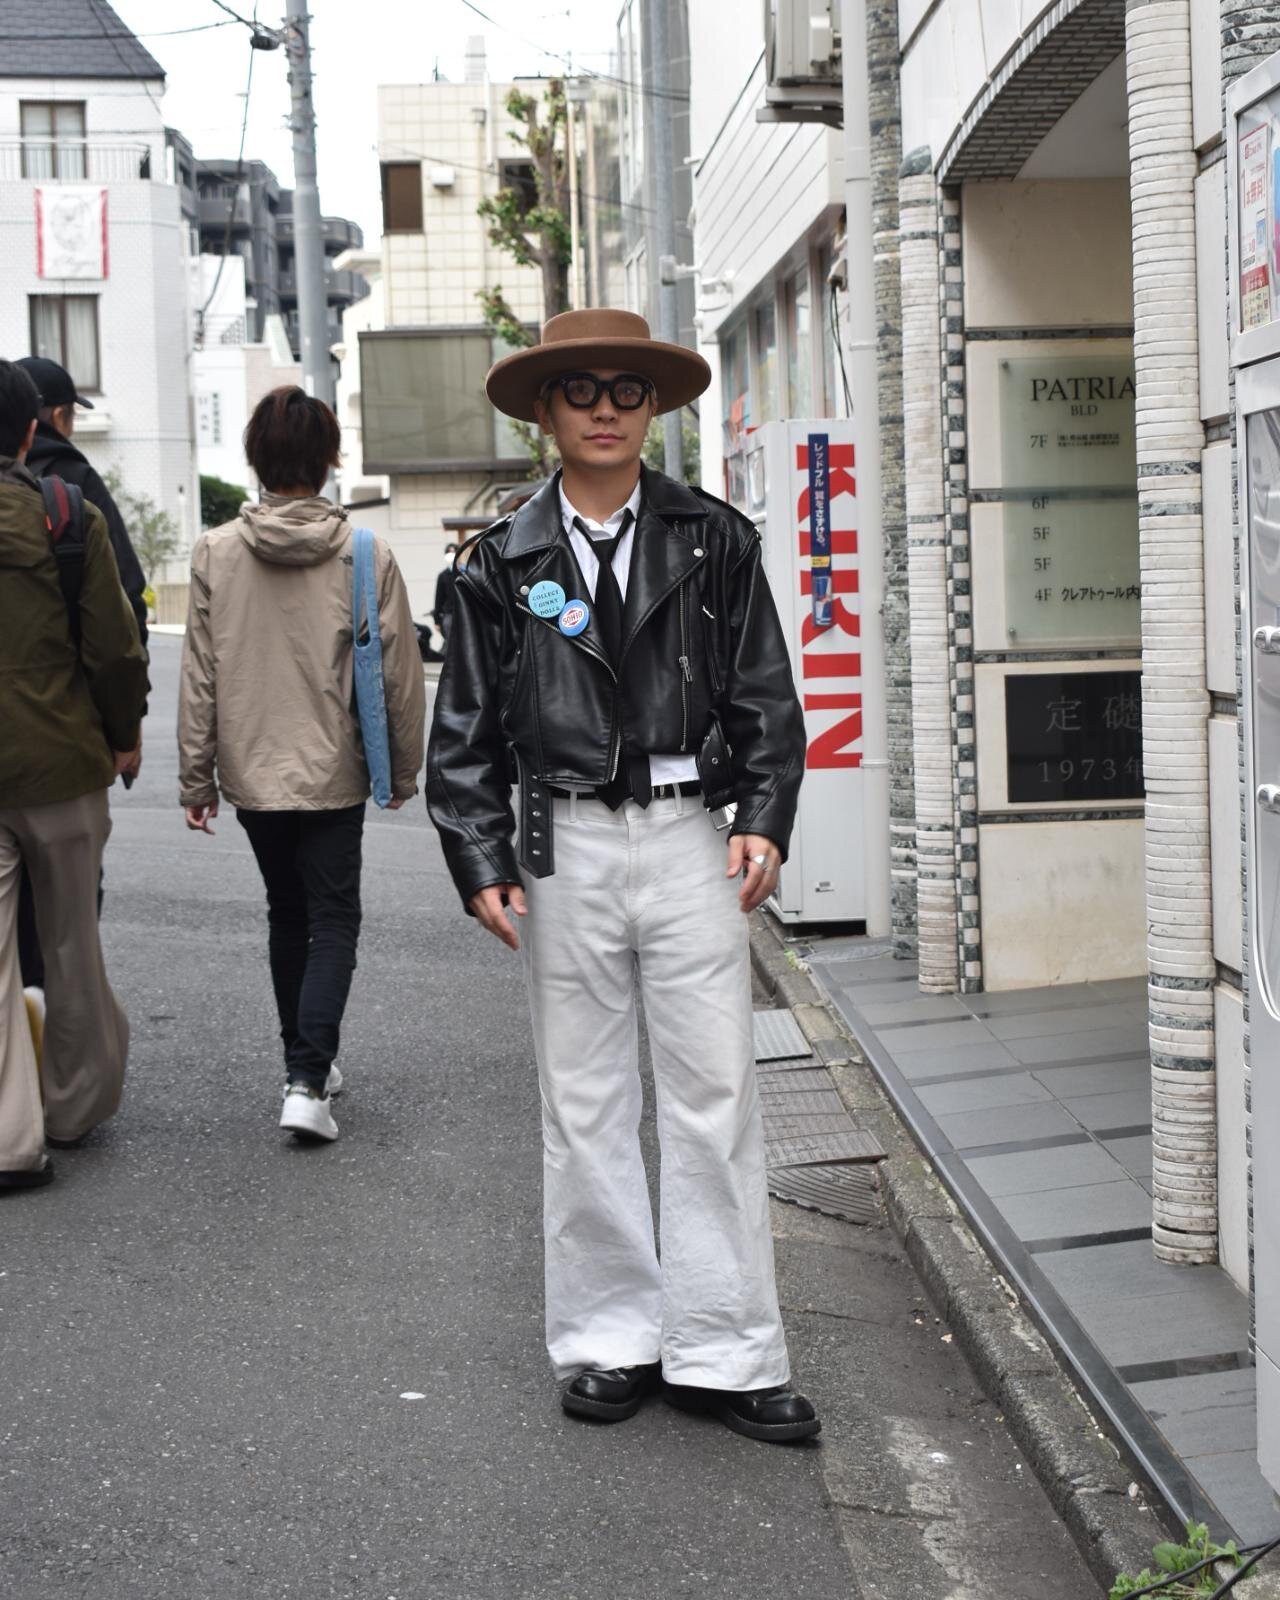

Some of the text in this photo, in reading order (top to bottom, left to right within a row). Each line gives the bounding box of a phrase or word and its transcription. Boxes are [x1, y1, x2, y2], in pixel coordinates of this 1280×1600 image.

[1031, 376, 1137, 401] PATRIA
[1070, 404, 1098, 417] BLD
[1030, 434, 1049, 449] 7F
[1031, 496, 1050, 510] 6F
[1033, 527, 1051, 541] 5F
[1034, 558, 1052, 572] 5F
[532, 589, 560, 601] COLLECT
[1034, 587, 1052, 601] 4F
[796, 443, 863, 770] KIRIN
[563, 610, 583, 624] SOHIO
